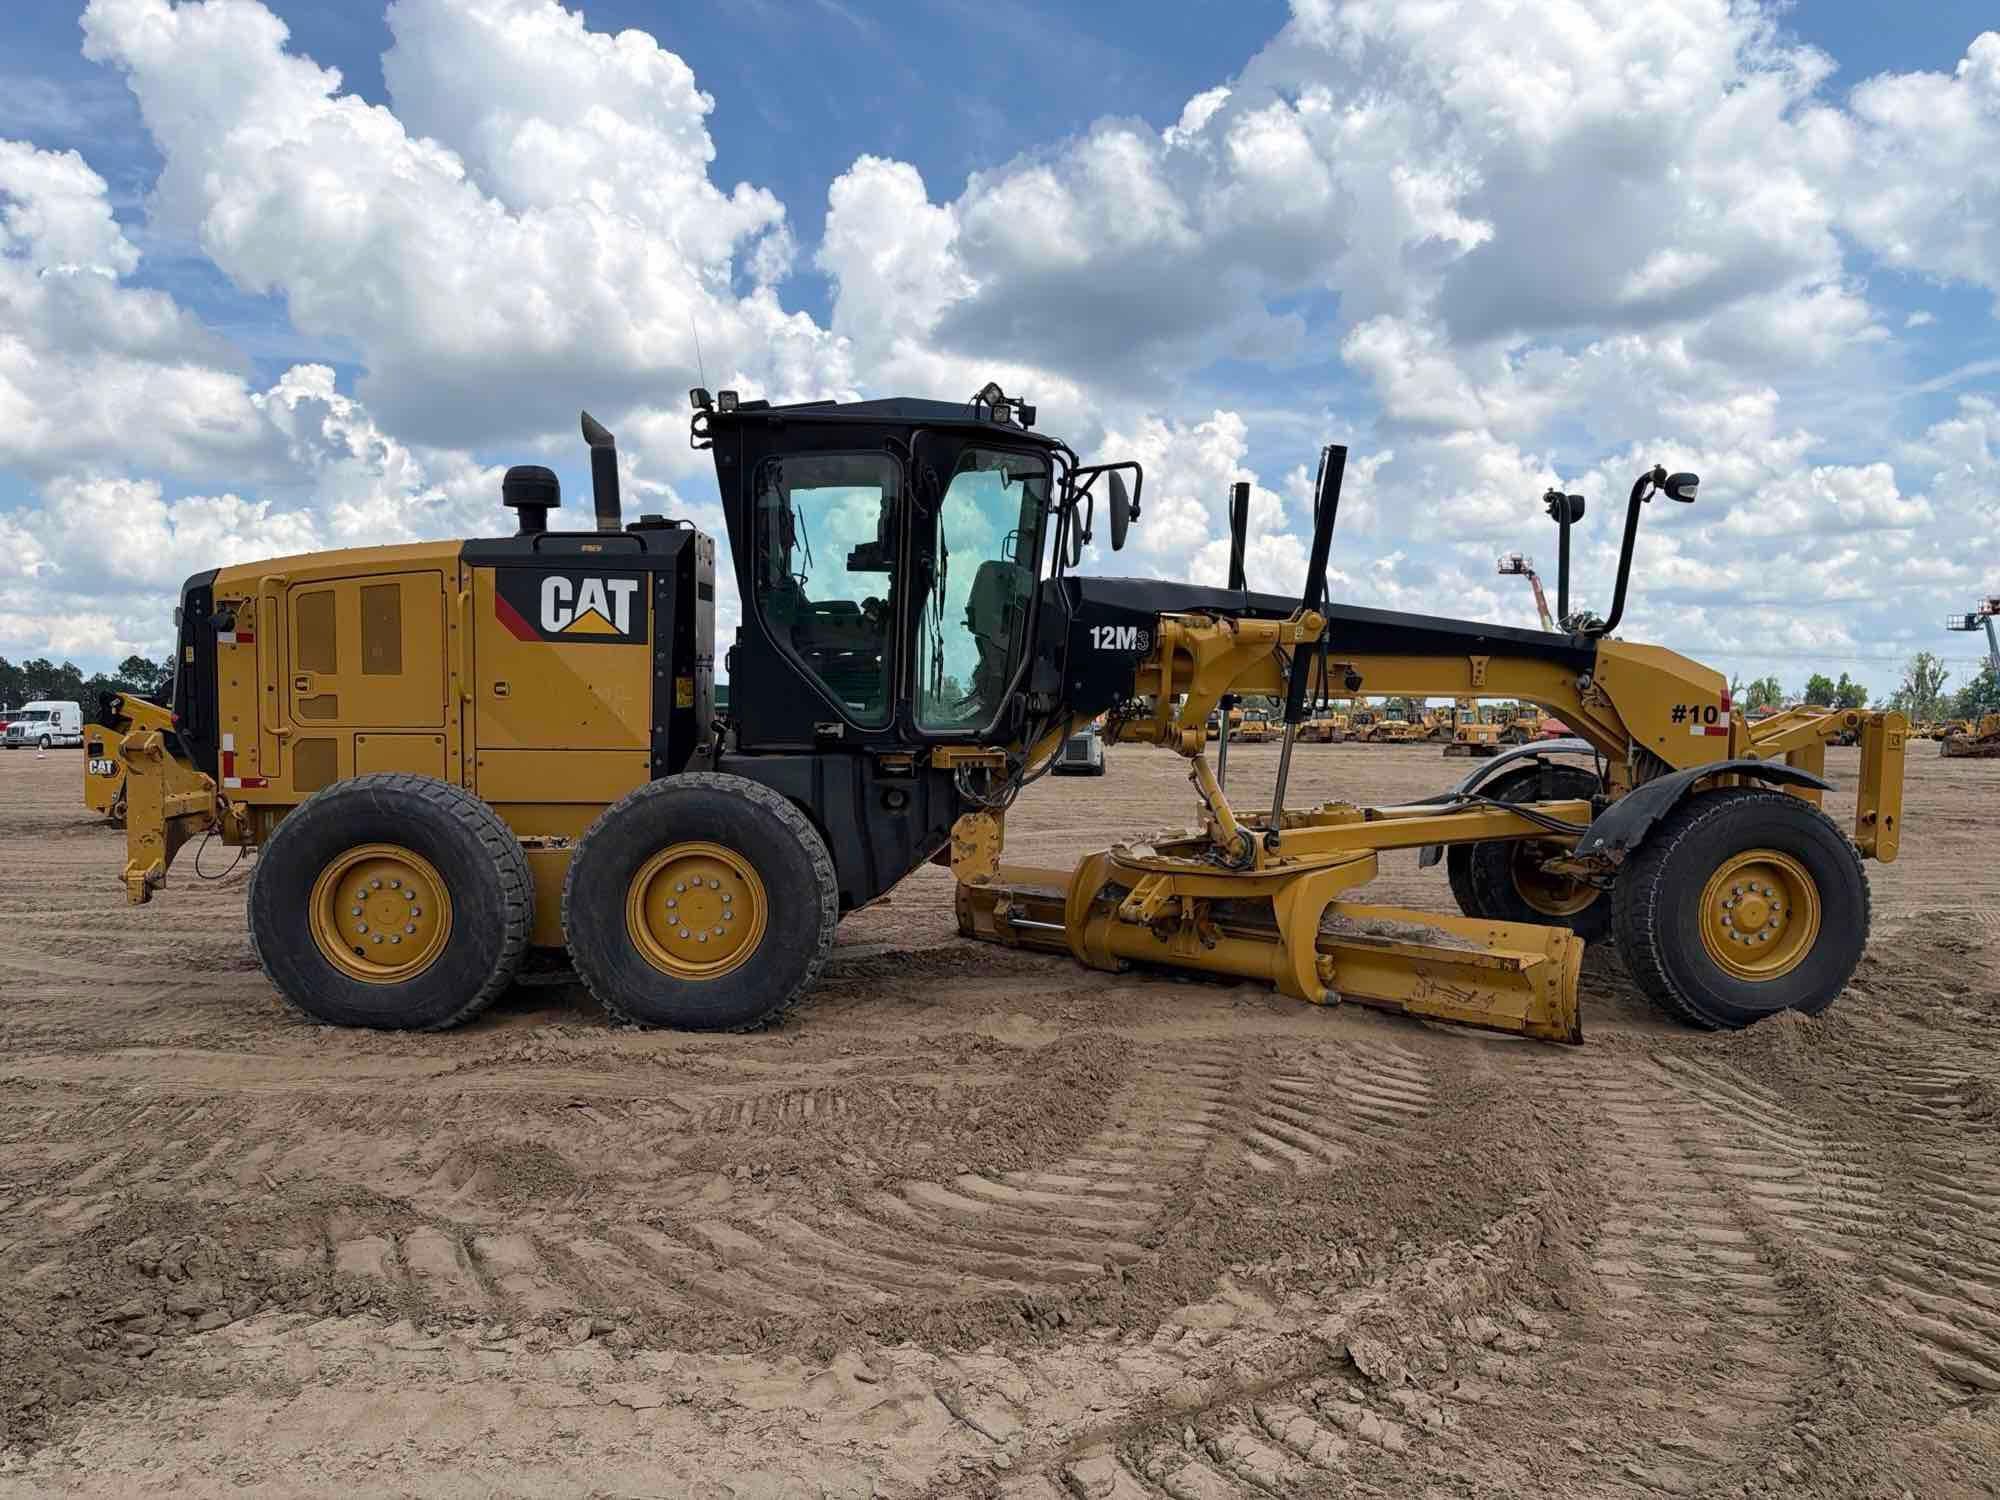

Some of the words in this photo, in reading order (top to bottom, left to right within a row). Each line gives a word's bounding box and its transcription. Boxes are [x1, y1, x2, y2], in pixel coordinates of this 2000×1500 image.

[541, 576, 638, 634] CAT
[1672, 705, 1718, 724] #10
[89, 760, 113, 774] CAT
